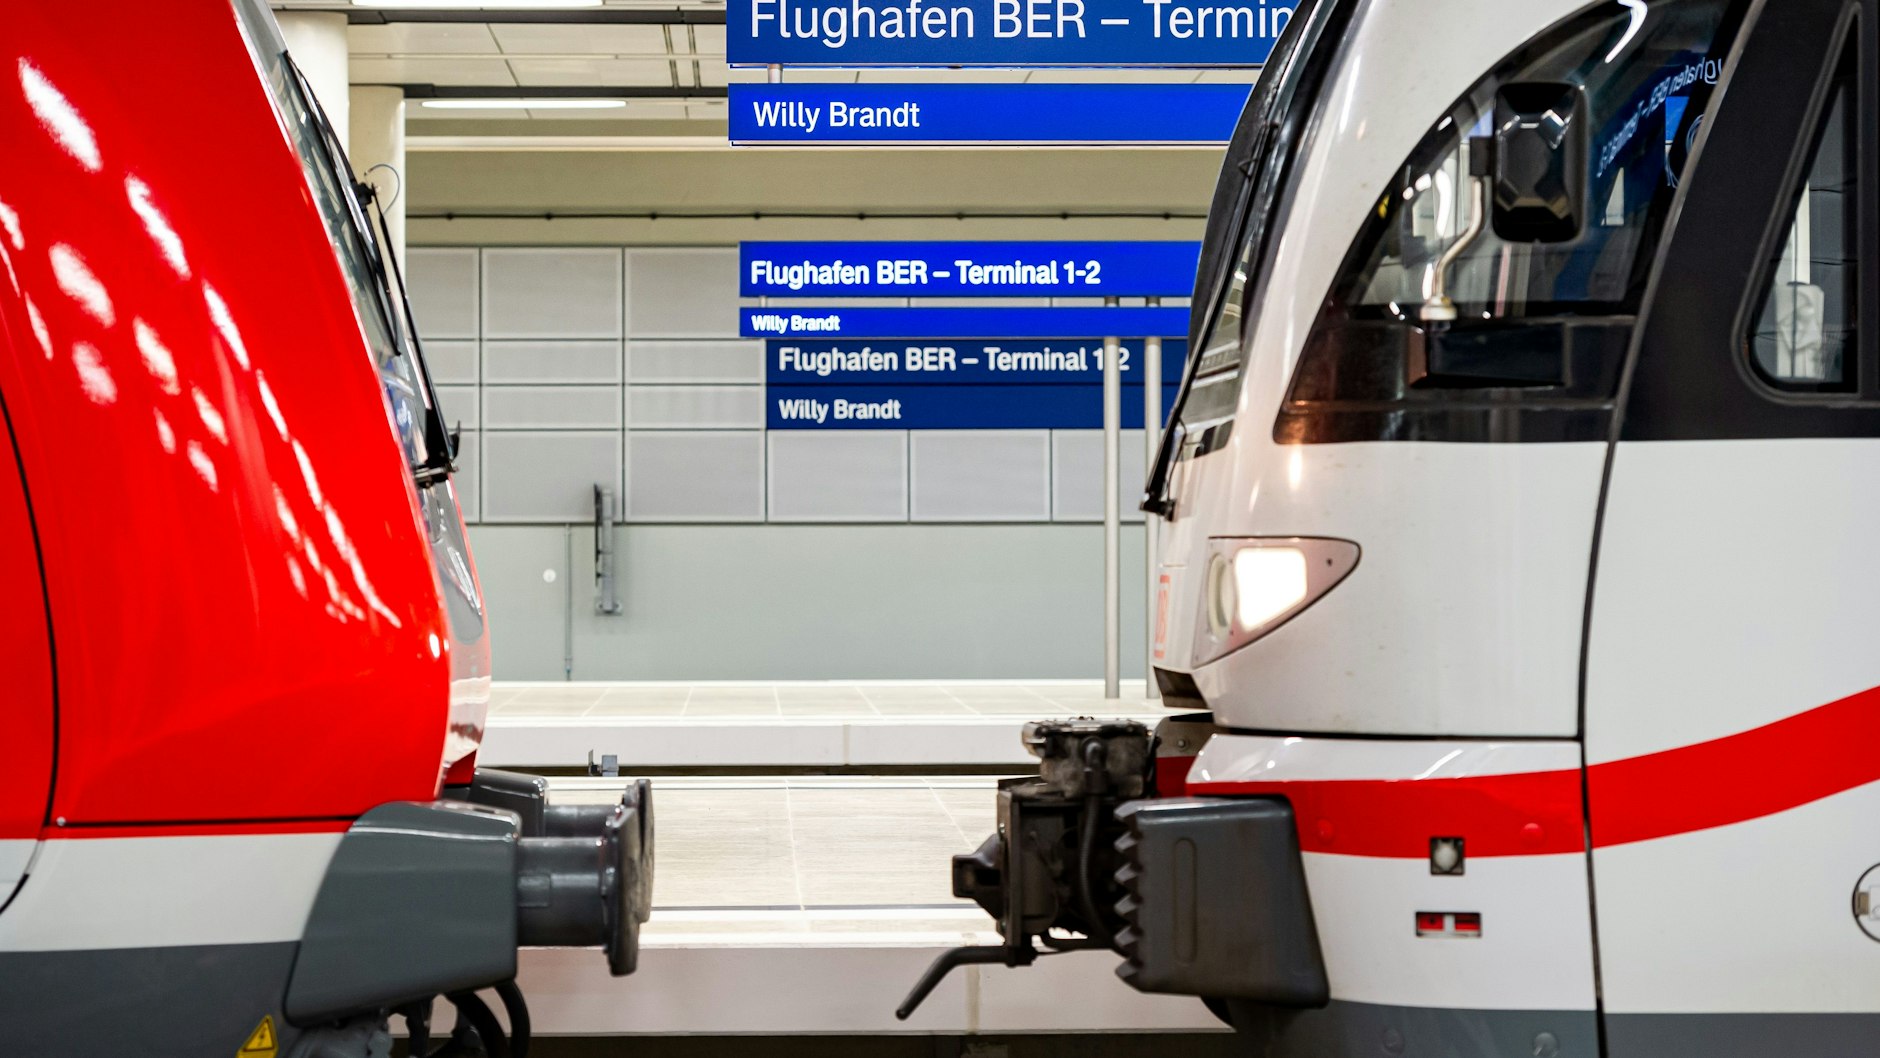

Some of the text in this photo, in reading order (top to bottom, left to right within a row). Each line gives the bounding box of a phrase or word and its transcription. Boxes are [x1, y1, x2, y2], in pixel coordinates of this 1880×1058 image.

[752, 0, 973, 48] Flughafen
[994, 0, 1085, 38] BER
[1143, 0, 1293, 38] Termin
[753, 101, 920, 132] Willy Brandt
[751, 259, 870, 290] Flughafen
[876, 260, 928, 285] BER
[954, 259, 1059, 285] Terminal
[1063, 260, 1101, 285] 1-2
[751, 314, 840, 334] Willy Brandt
[779, 346, 899, 376] Flughafen
[905, 346, 957, 371] BER
[983, 346, 1088, 371] Terminal
[1092, 346, 1130, 371] 12
[778, 398, 902, 424] Willy Brandt
